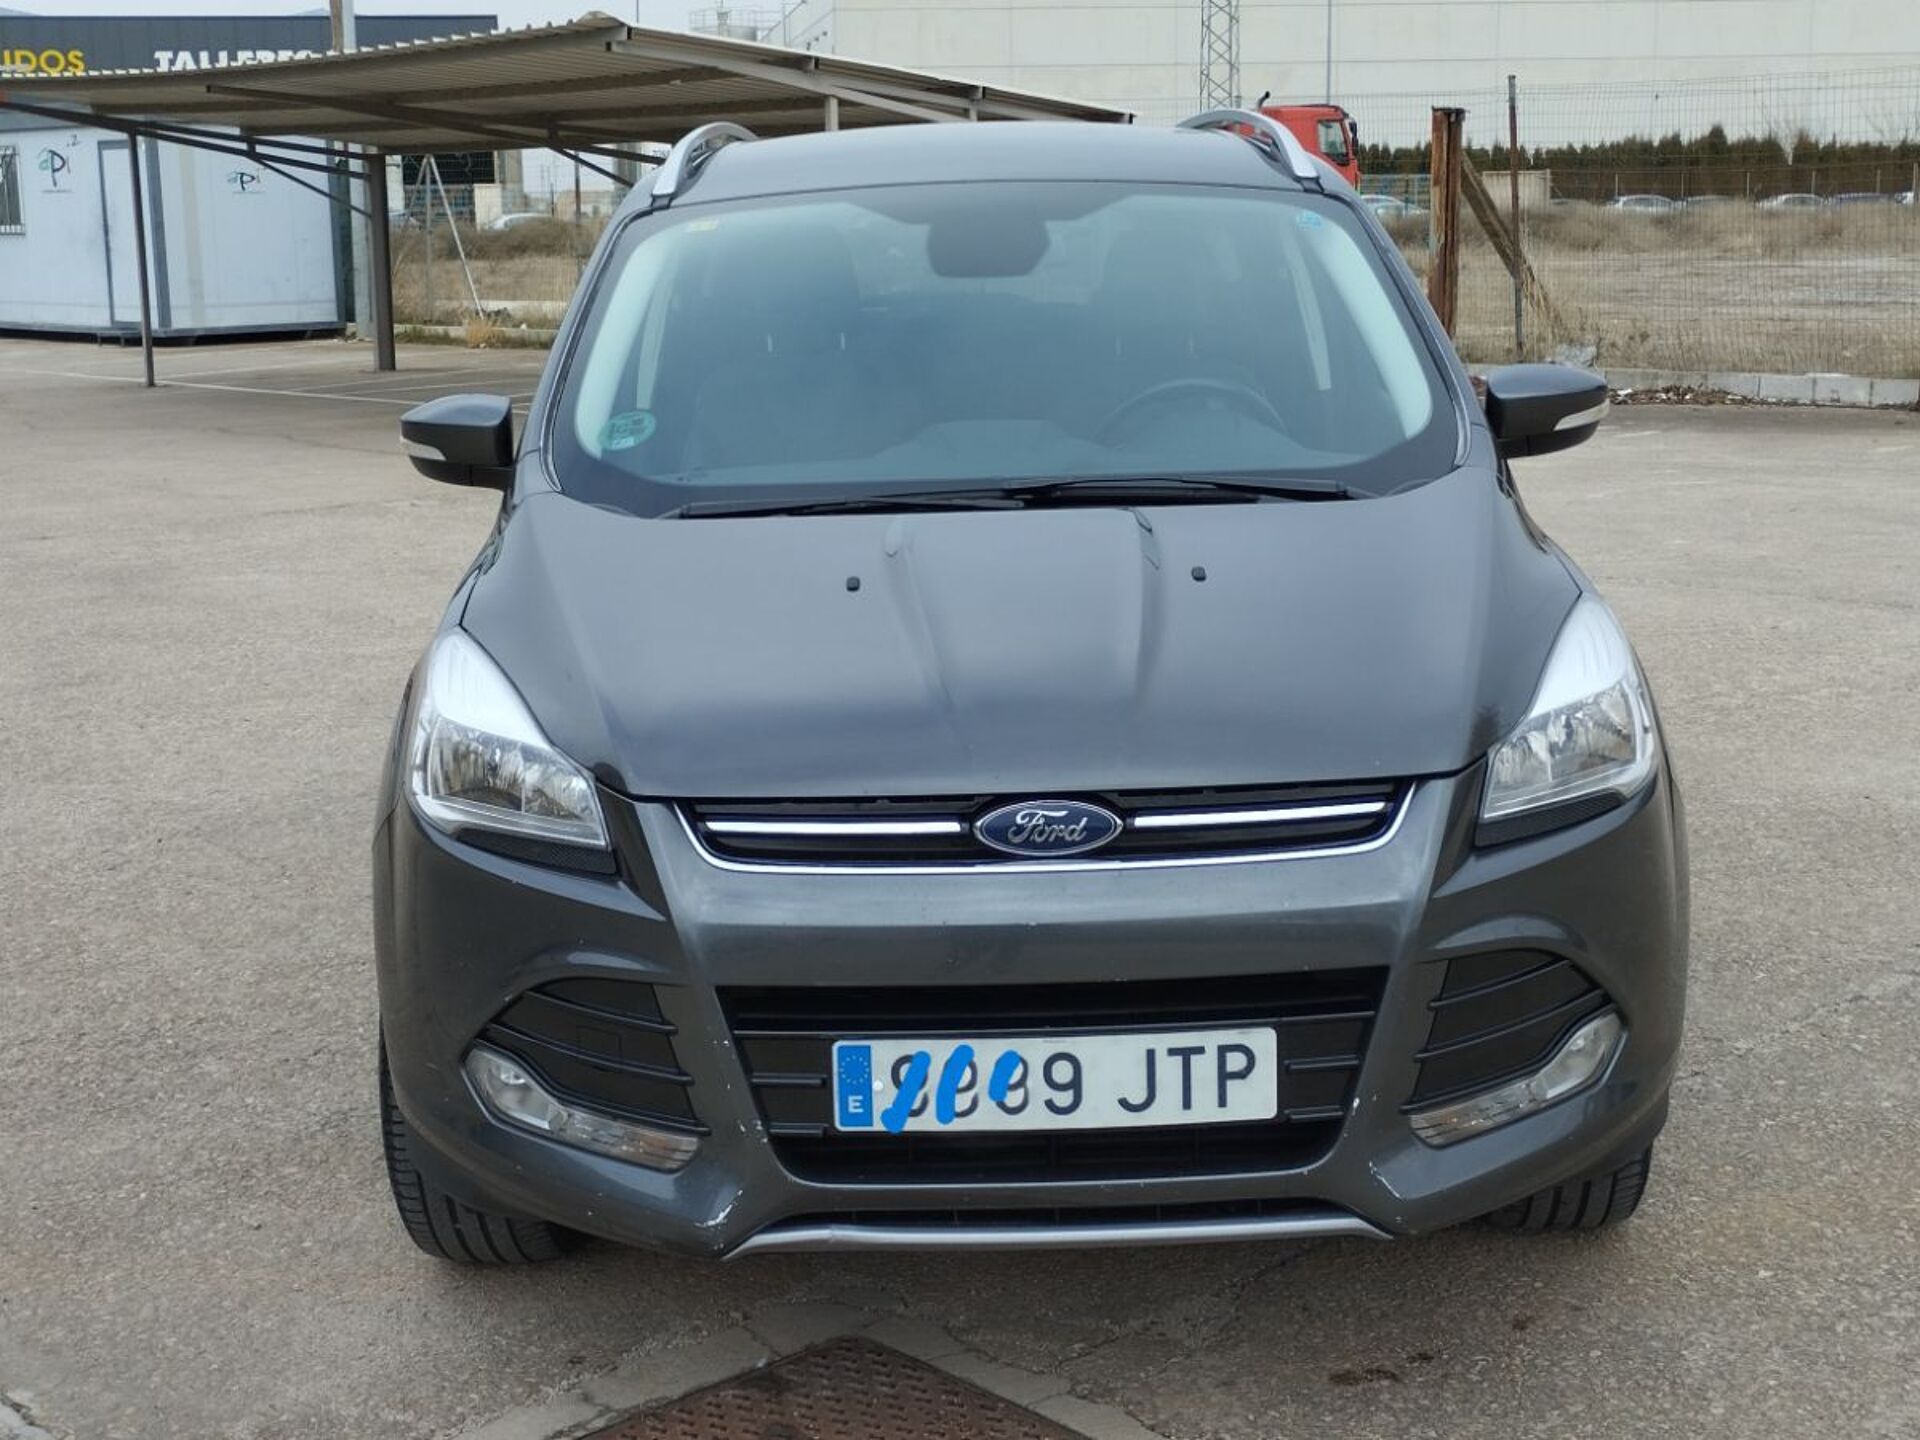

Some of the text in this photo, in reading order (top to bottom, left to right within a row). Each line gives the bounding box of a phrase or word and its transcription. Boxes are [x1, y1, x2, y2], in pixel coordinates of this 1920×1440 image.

[1007, 809, 1089, 844] Ford
[1117, 1043, 1257, 1113] JTP
[847, 1095, 864, 1113] E
